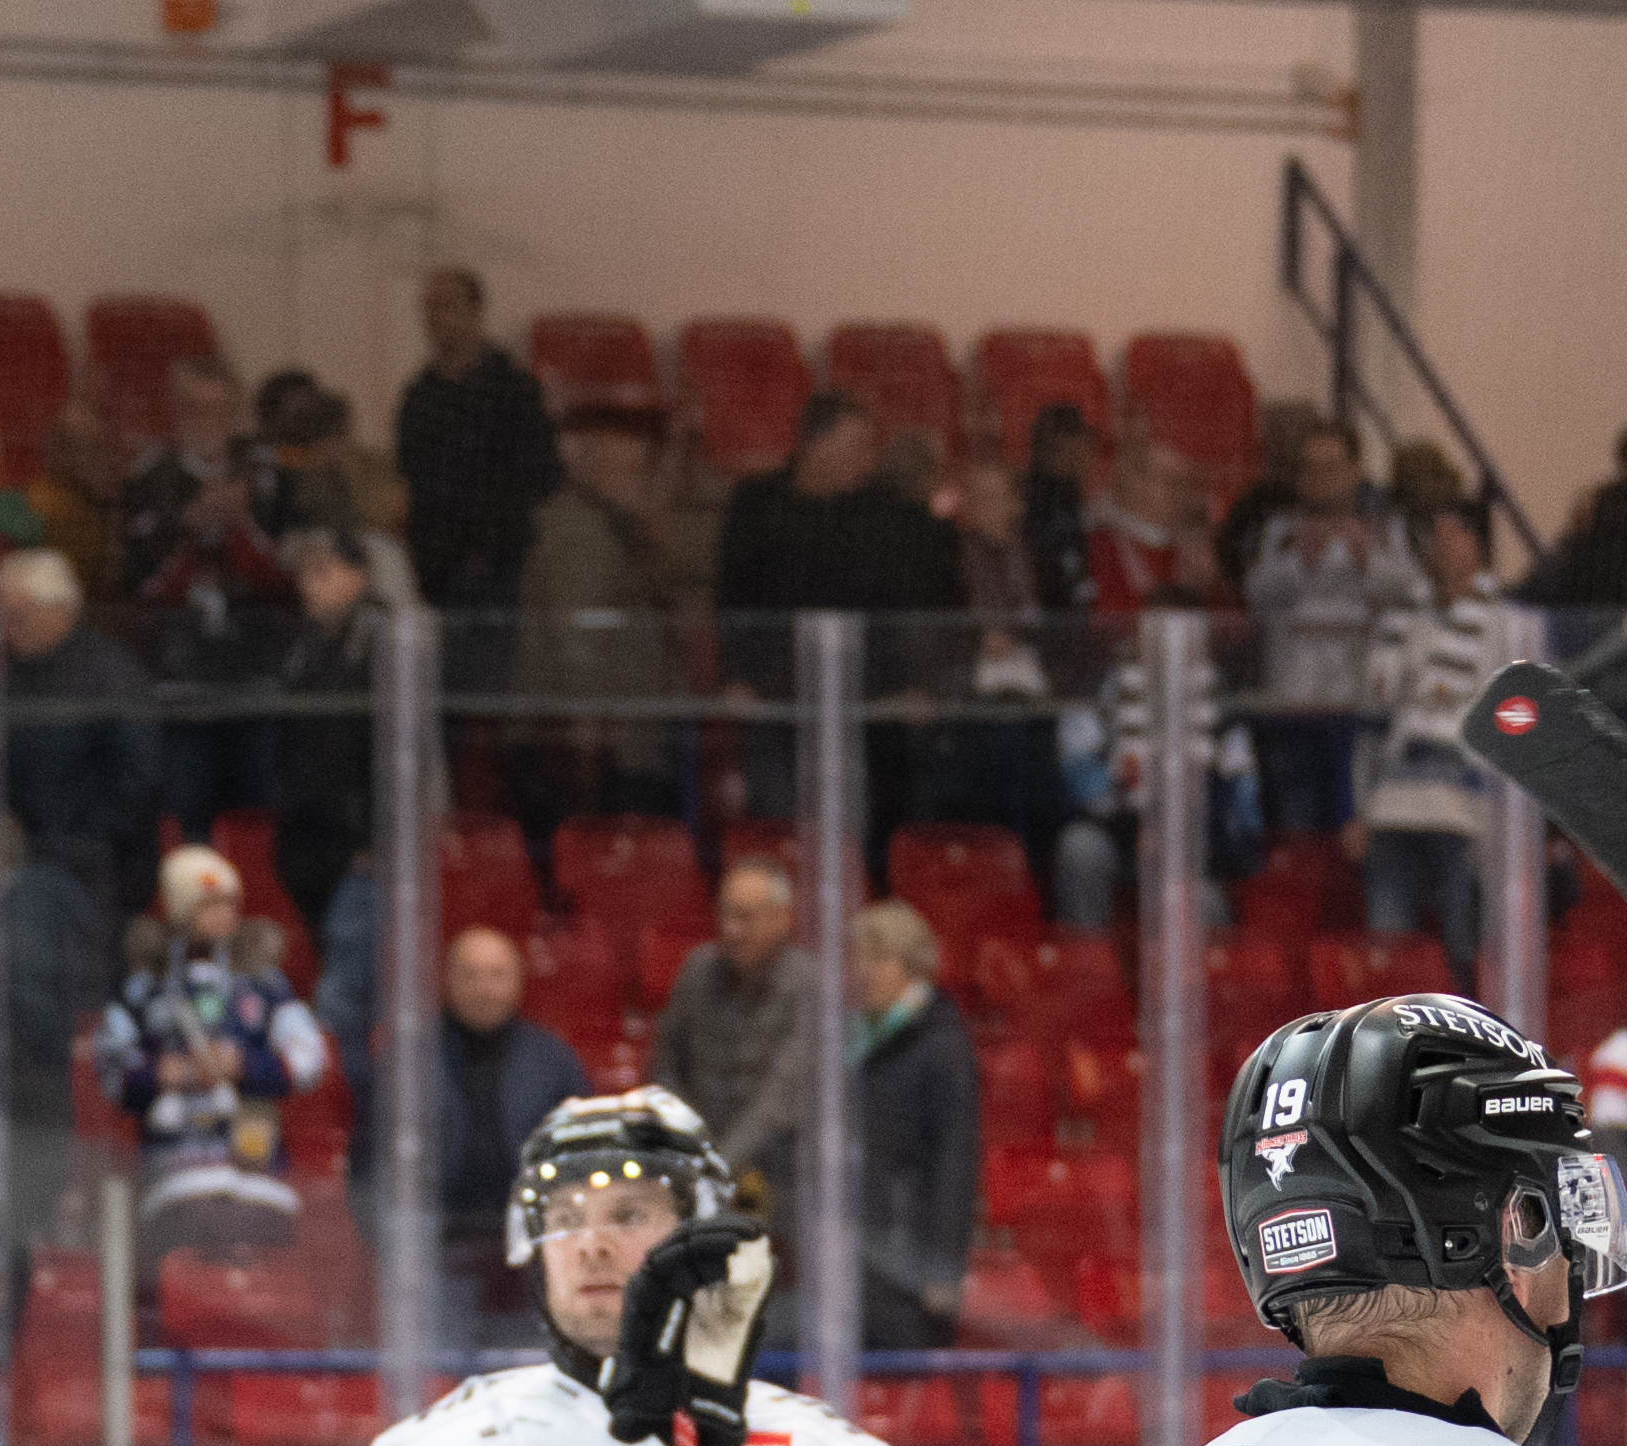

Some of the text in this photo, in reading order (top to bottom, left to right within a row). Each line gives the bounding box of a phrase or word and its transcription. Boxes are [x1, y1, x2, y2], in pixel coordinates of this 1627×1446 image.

[328, 62, 387, 166] F
[1392, 1003, 1548, 1070] STETSON
[1262, 1078, 1308, 1130] 19
[1485, 1096, 1554, 1115] BAUER
[1263, 1215, 1329, 1252] STETSON
